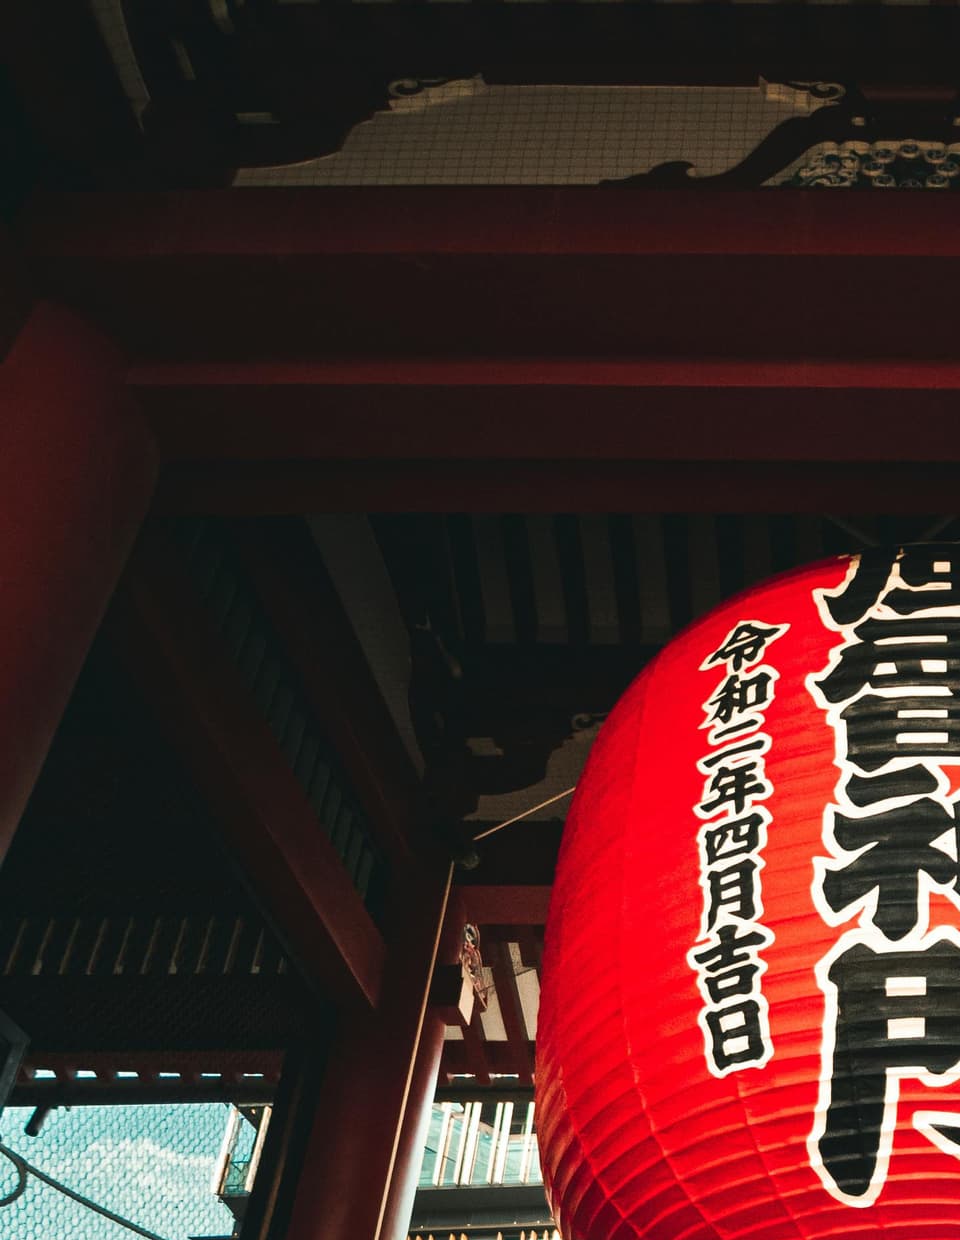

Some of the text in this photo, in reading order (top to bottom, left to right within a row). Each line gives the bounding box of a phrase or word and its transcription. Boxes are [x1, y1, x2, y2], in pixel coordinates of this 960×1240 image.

[691, 619, 789, 1078] 令和二年四月吉日
